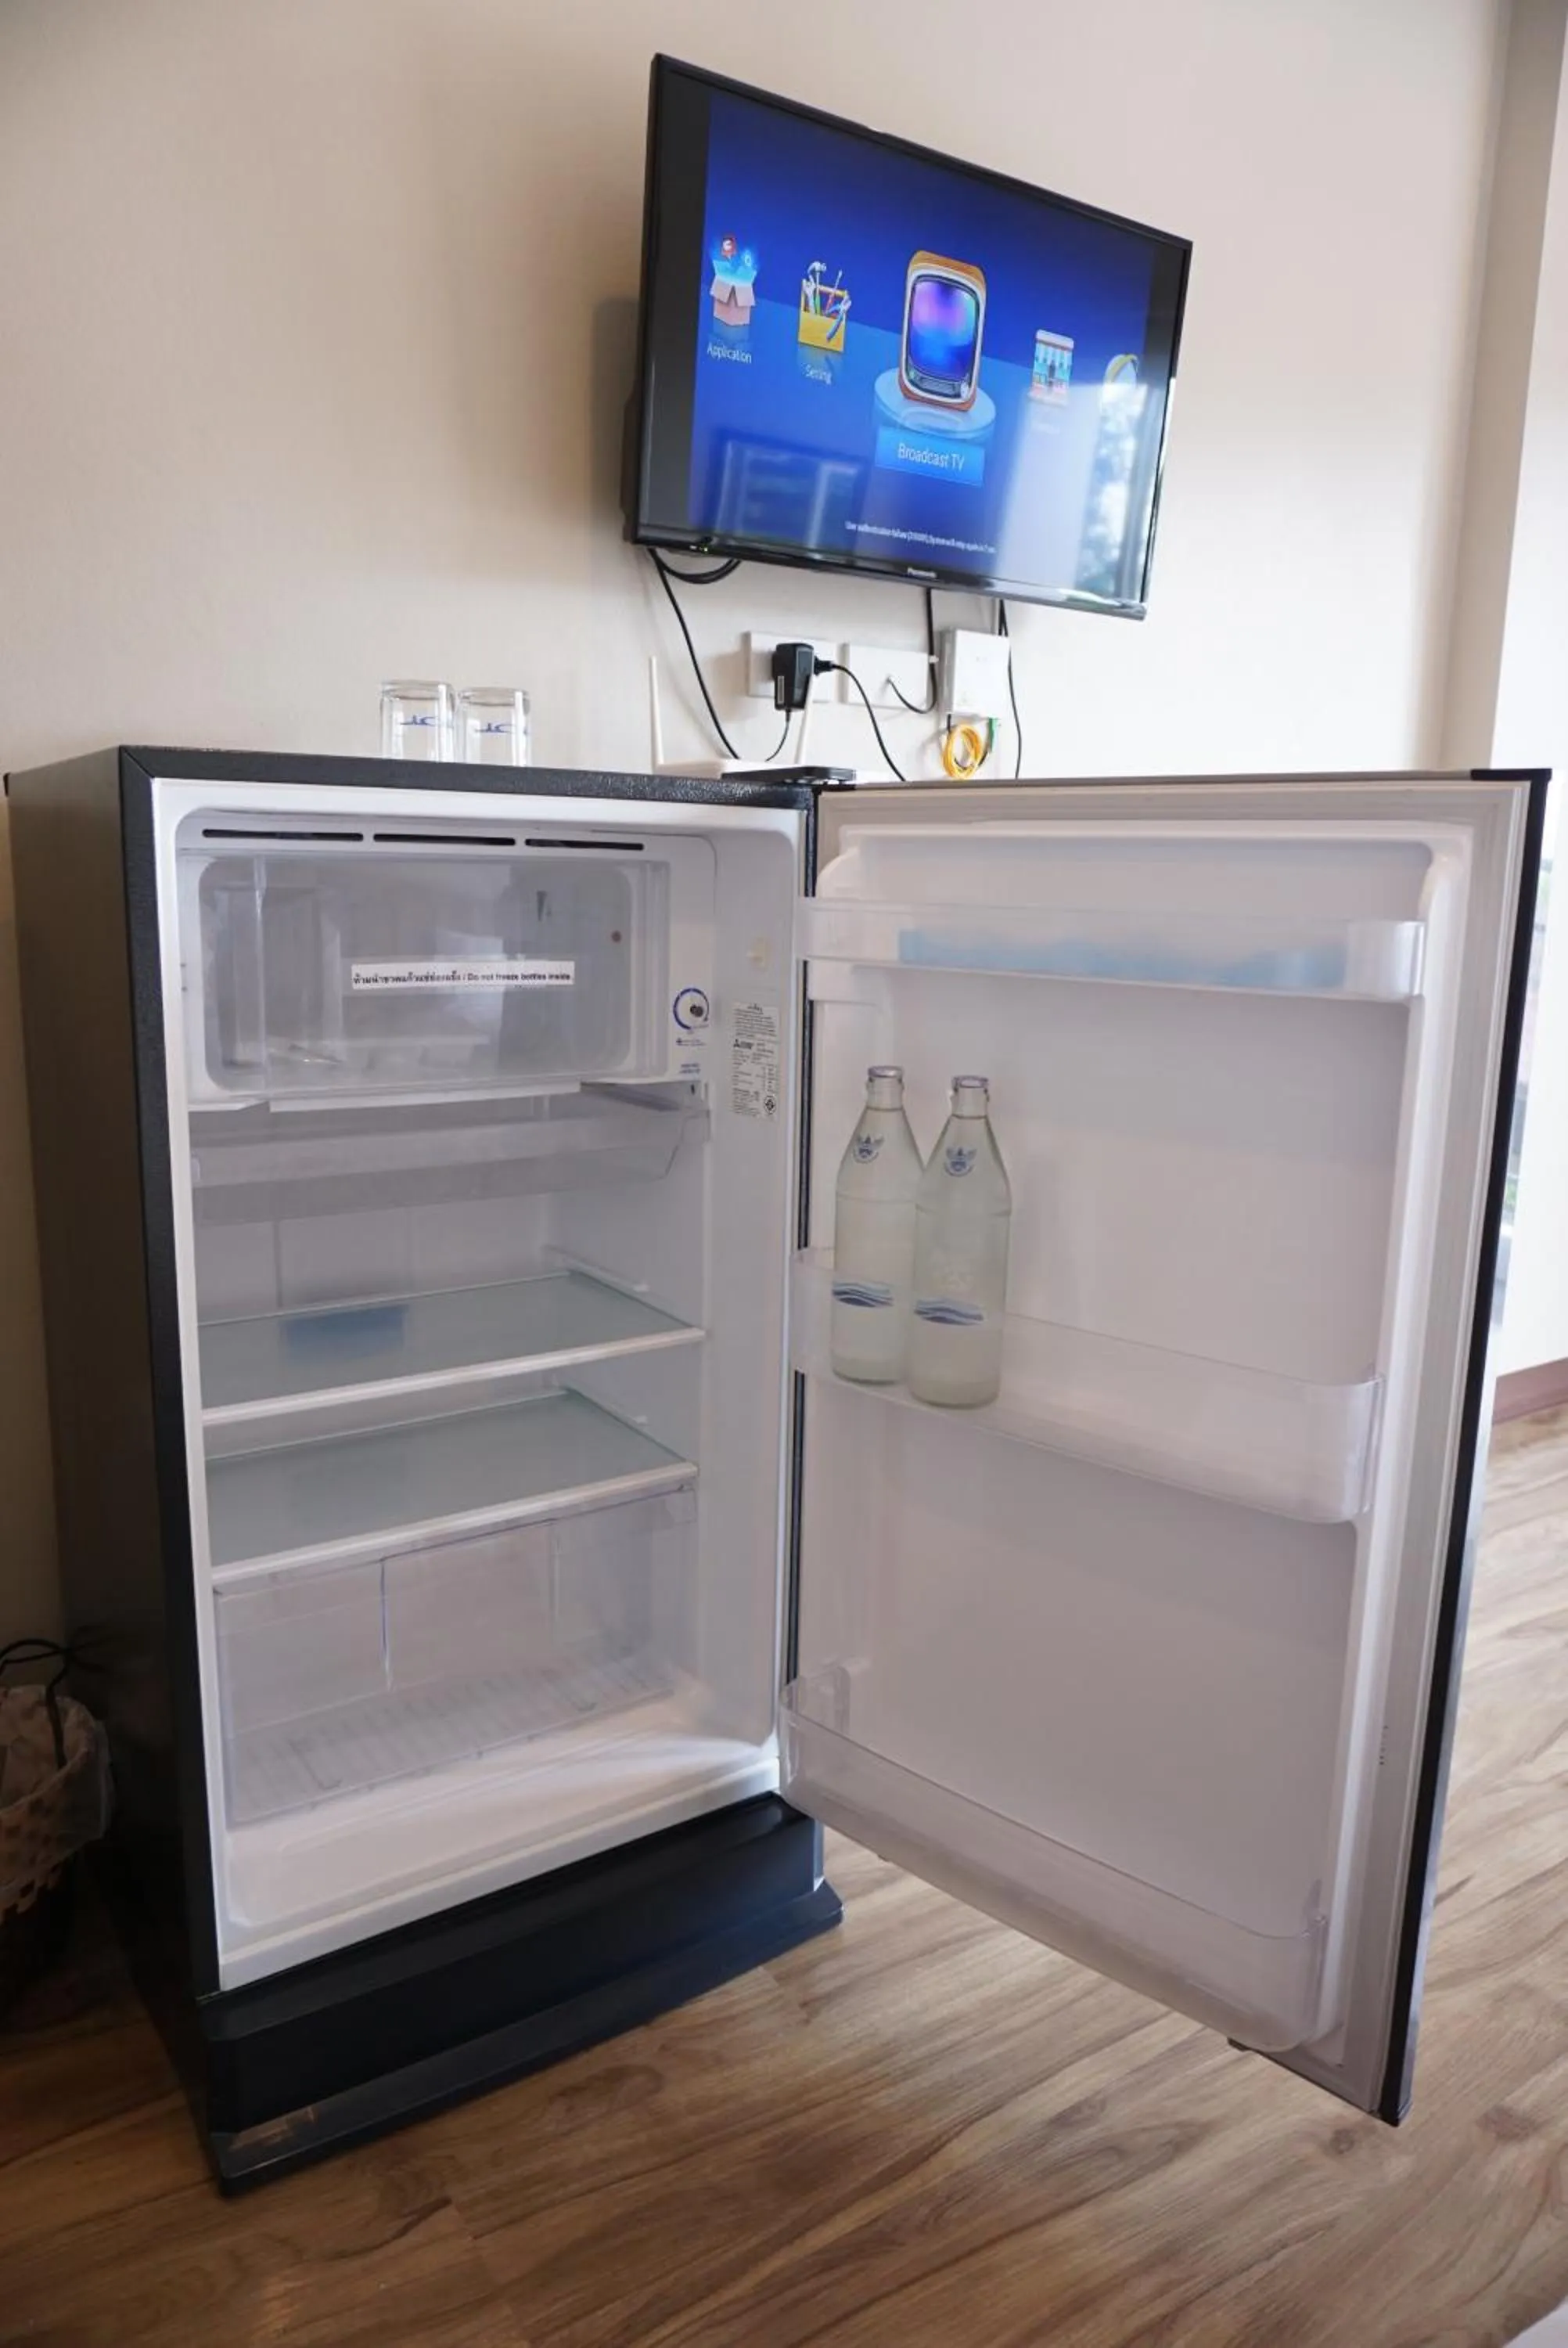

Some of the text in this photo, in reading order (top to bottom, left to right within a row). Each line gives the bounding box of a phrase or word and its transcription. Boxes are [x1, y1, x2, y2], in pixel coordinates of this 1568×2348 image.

[707, 341, 752, 365] Application
[897, 443, 966, 471] Broadcast TV
